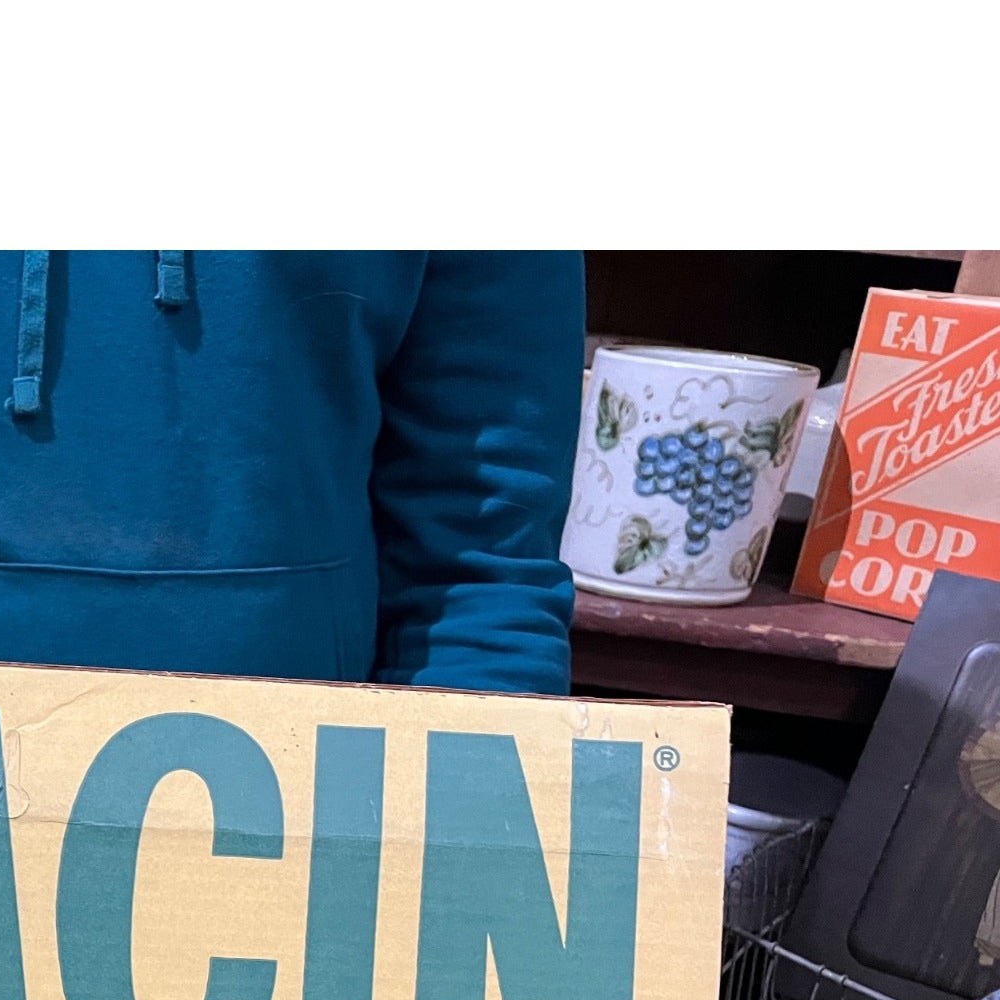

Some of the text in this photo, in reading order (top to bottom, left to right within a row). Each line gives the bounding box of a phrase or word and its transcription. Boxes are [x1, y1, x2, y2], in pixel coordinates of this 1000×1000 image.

[880, 311, 960, 357] EAT
[892, 348, 1000, 443] Fres
[855, 509, 977, 564] POP
